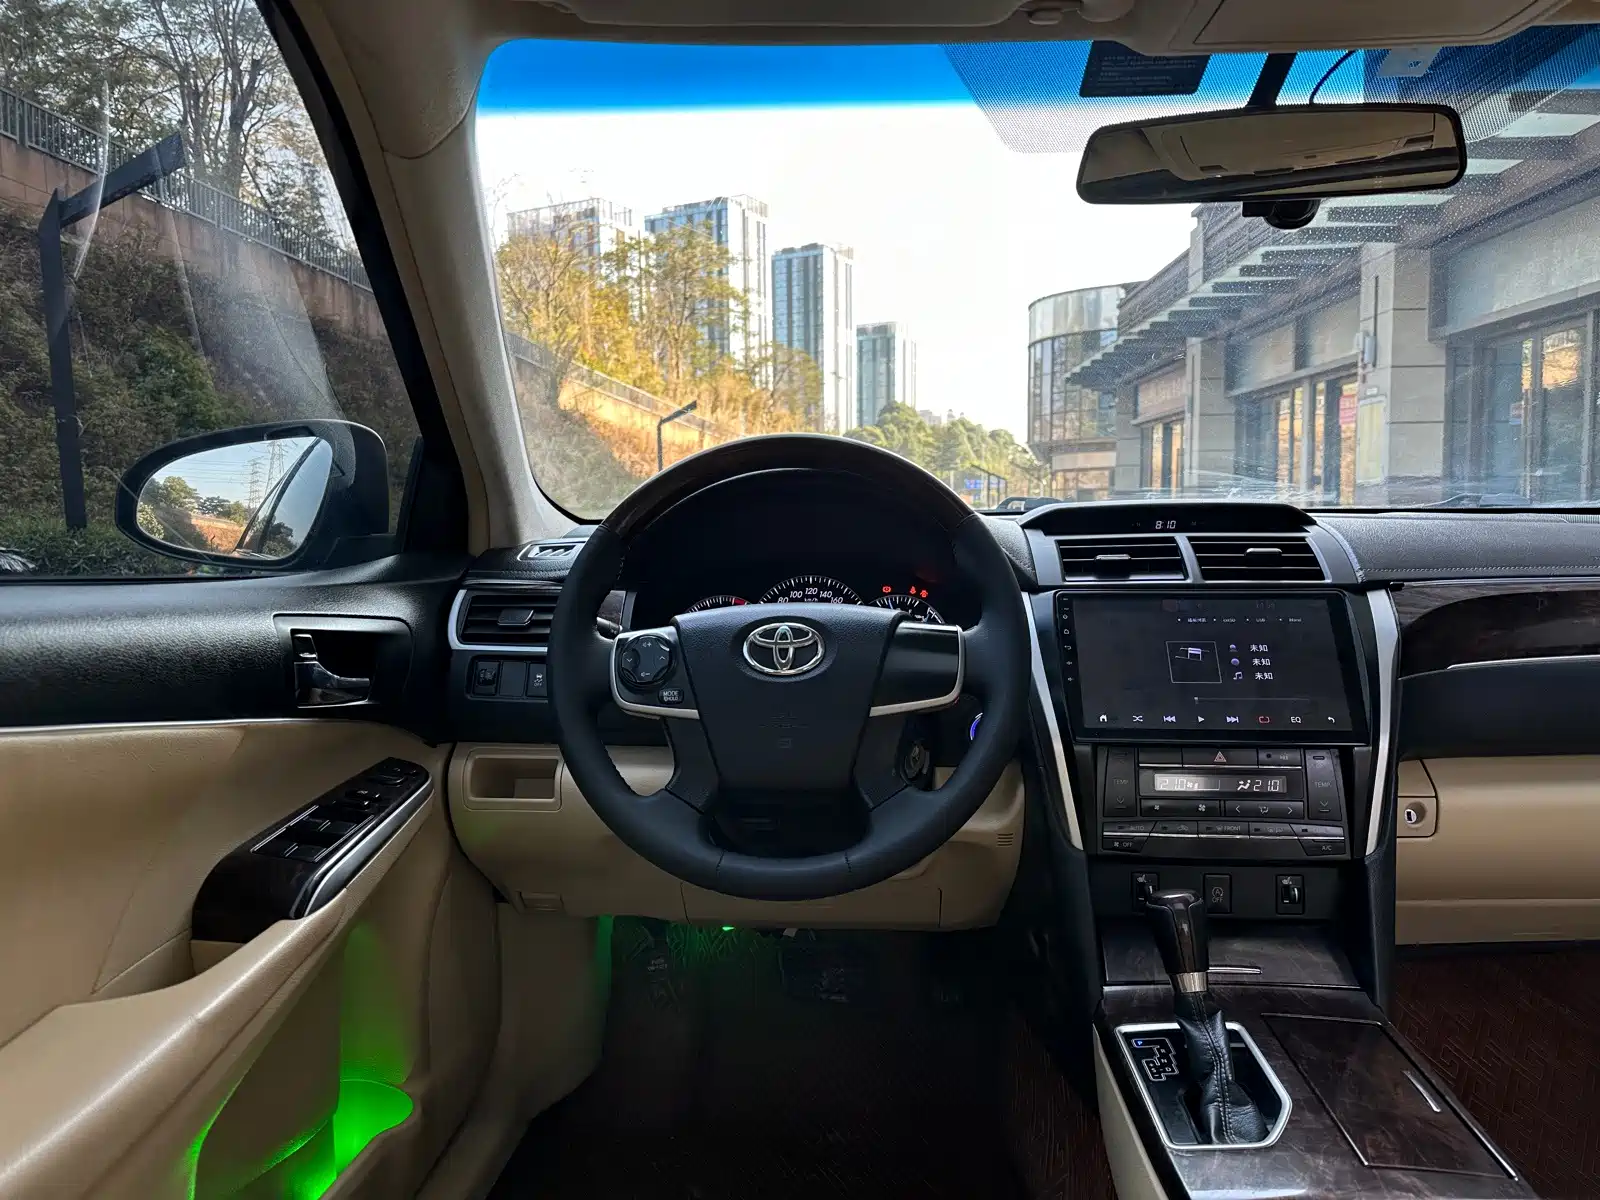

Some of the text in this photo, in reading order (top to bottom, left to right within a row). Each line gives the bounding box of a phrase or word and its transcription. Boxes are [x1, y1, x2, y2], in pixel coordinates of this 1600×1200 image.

[1155, 520, 1176, 529] 8:10
[789, 590, 803, 598] 100
[805, 587, 818, 595] 120
[819, 590, 833, 598] 140
[830, 596, 844, 604] 160
[1250, 644, 1268, 652] 未知
[1252, 658, 1271, 666] 未知
[1255, 672, 1273, 680] 未知
